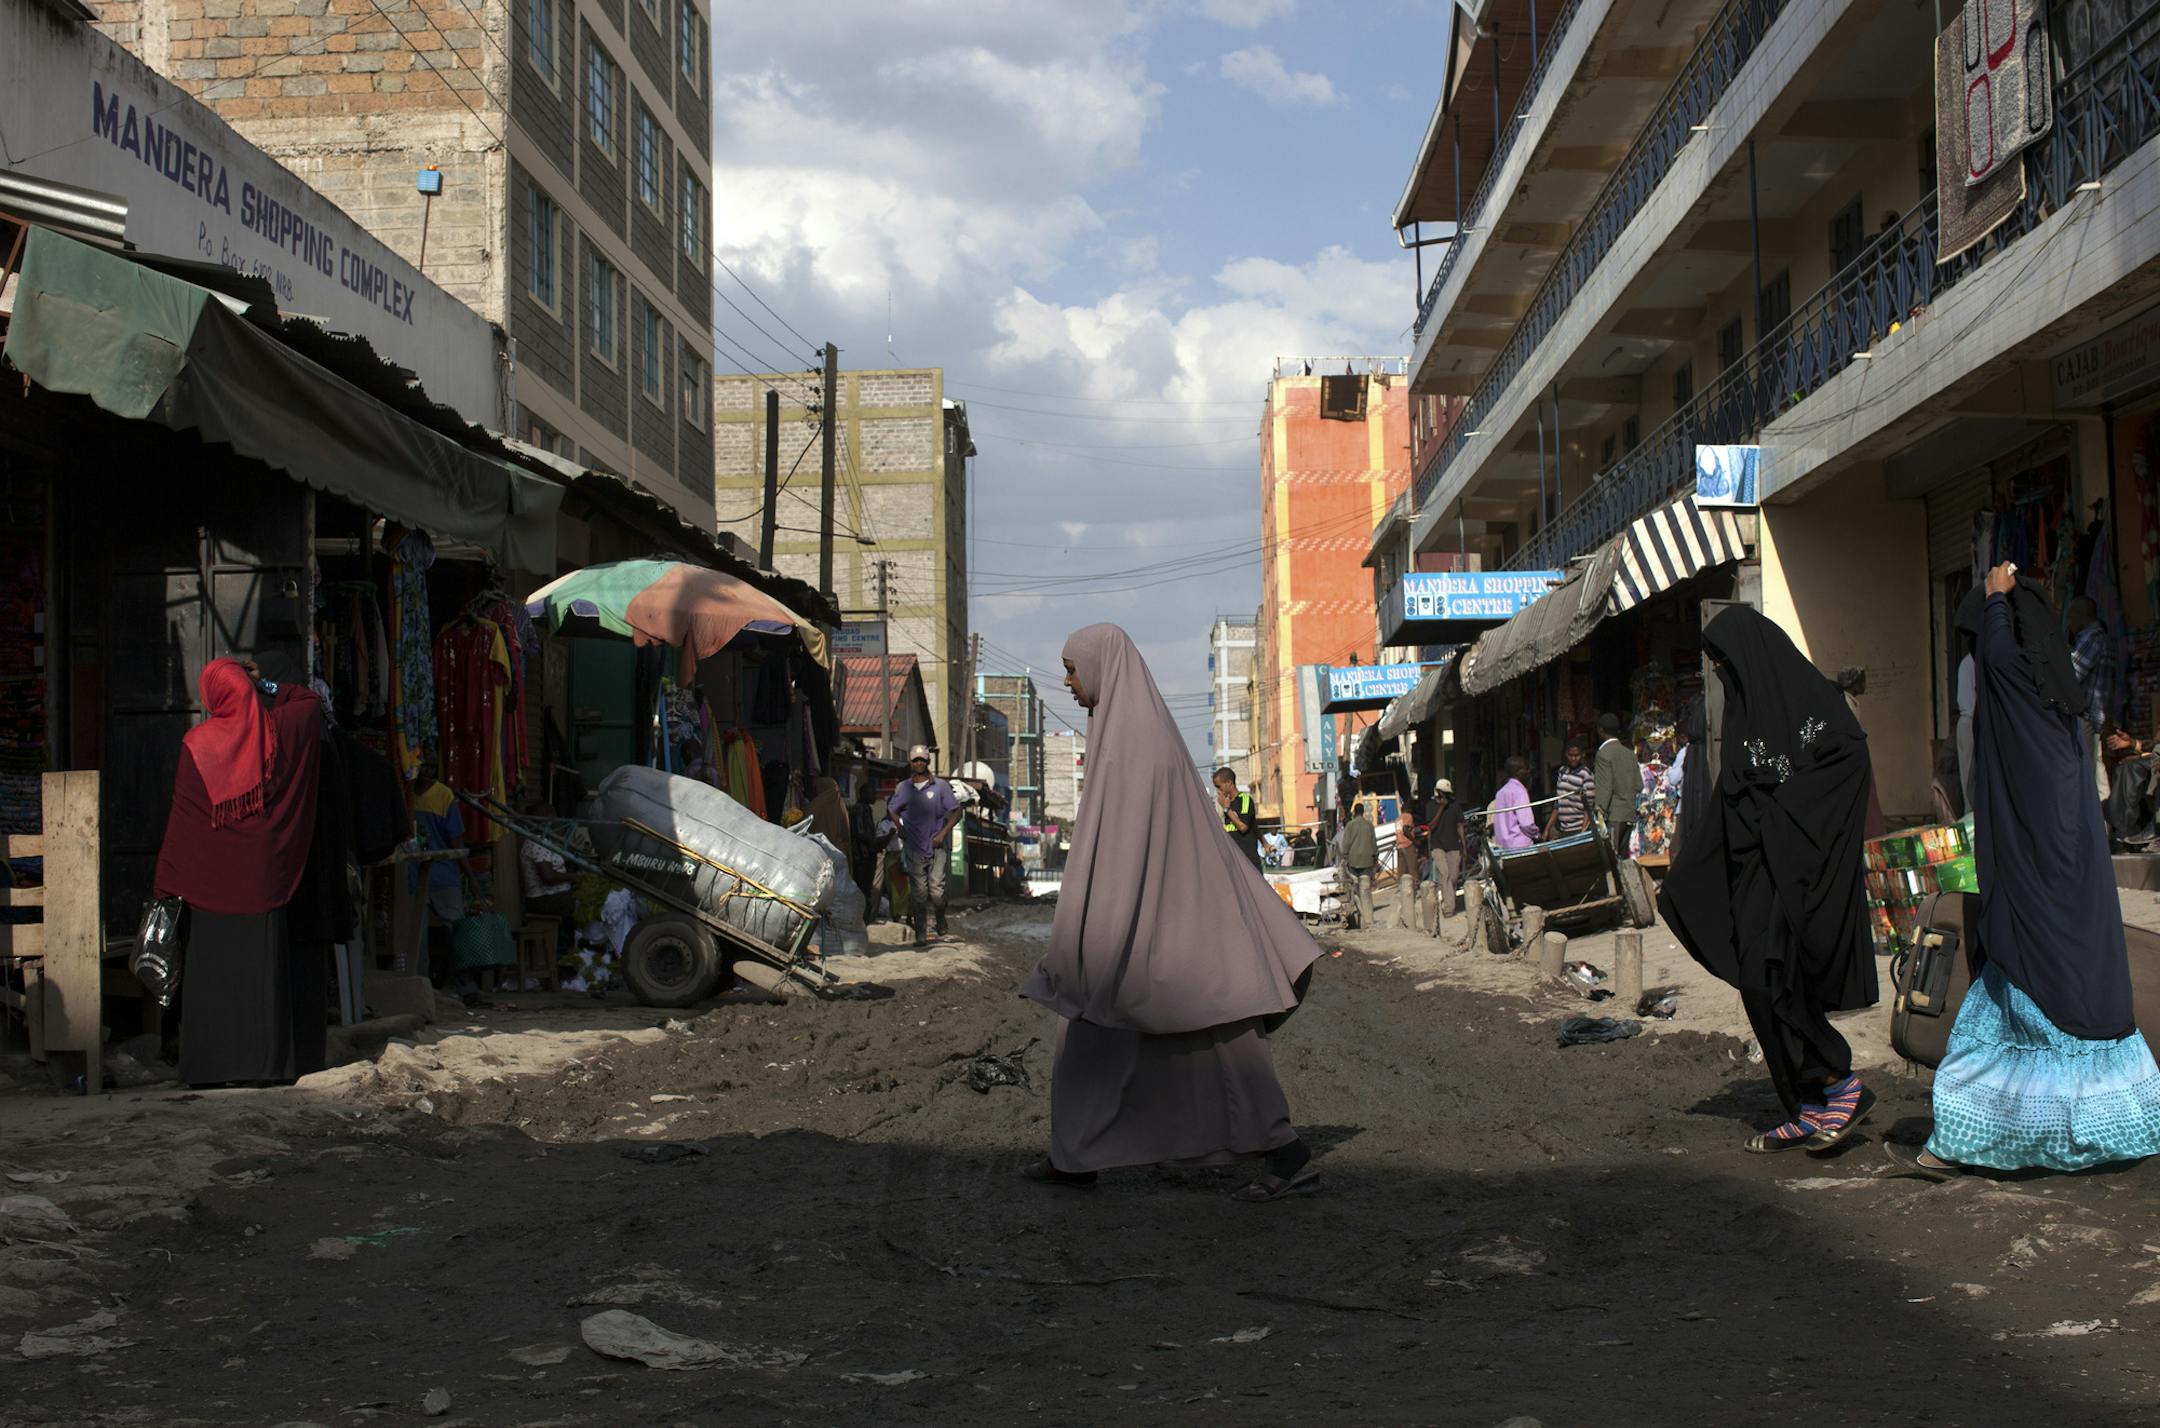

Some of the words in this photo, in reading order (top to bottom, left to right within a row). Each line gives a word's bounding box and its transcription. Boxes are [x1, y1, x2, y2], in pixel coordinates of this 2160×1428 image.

[93, 81, 232, 216] MANDERA
[241, 182, 334, 277] SHOPPING
[340, 247, 415, 326] COMPLEX
[2057, 345, 2098, 386] CAJAB
[1404, 577, 1480, 594] MANDERA
[1452, 598, 1512, 615] CENTRE
[1330, 668, 1383, 685] MANDERA
[1365, 682, 1409, 696] CENTRE
[1312, 762, 1334, 770] LTD
